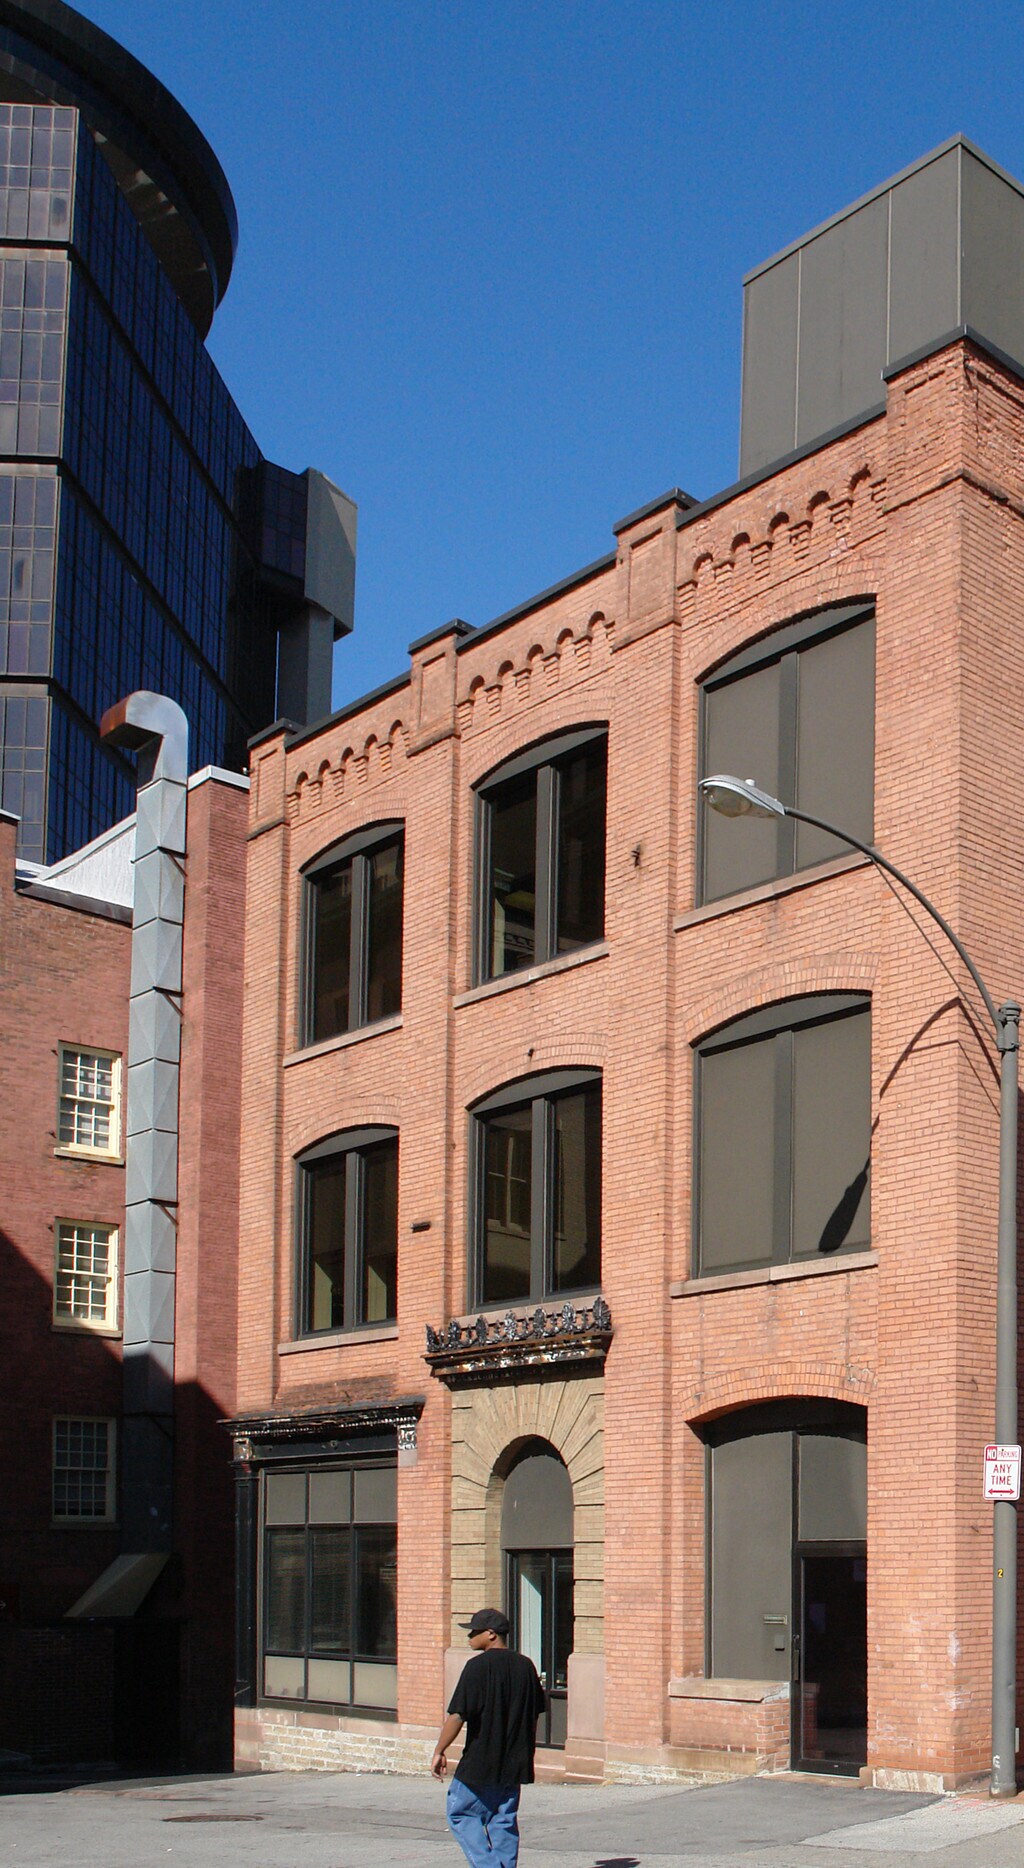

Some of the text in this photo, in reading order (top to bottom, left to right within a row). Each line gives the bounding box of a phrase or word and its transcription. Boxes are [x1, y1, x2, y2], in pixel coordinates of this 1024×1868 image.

[987, 1448, 997, 1460] NO
[993, 1464, 1012, 1474] ANY
[991, 1475, 1012, 1486] TIME
[997, 1567, 1004, 1579] 2
